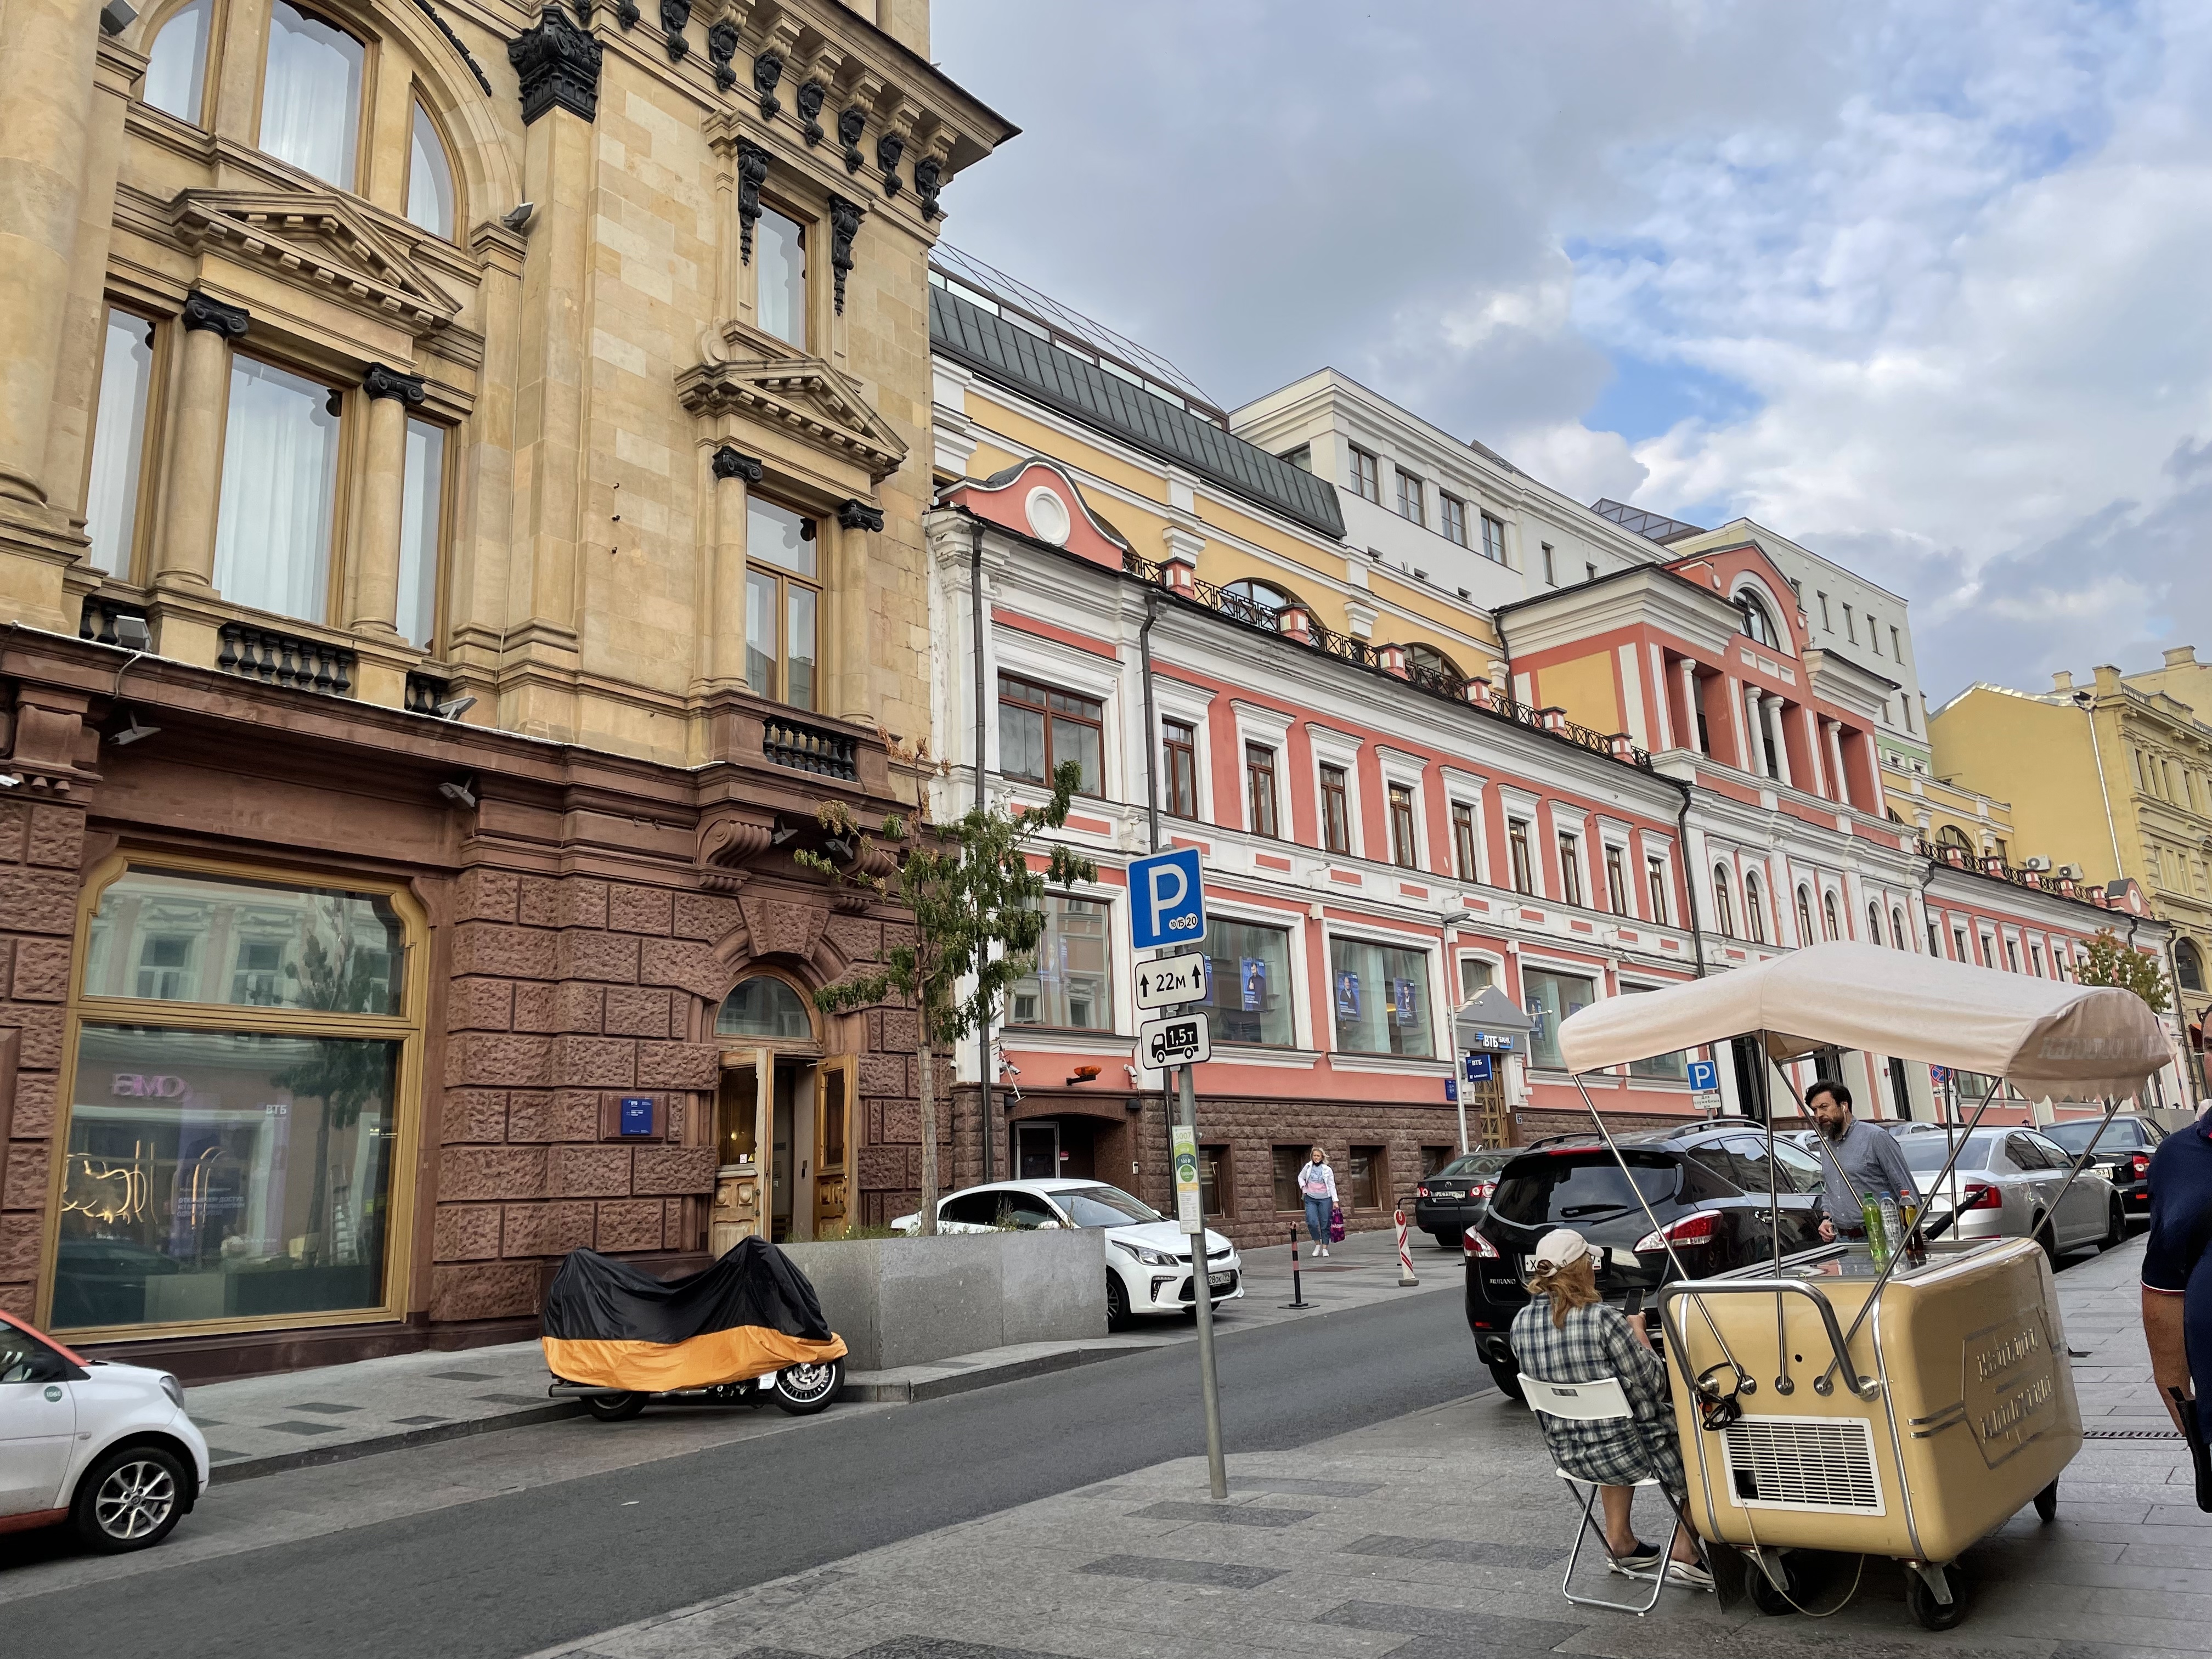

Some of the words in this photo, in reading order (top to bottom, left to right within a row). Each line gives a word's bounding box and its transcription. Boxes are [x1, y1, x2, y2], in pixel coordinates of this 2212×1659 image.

[1148, 863, 1188, 937] P
[1178, 919, 1184, 927] 15
[1186, 916, 1197, 926] 20
[1483, 1035, 1498, 1048] ВТБ
[1694, 1065, 1711, 1087] P
[266, 1104, 287, 1114] ВТБ
[1175, 1132, 1192, 1140] 5007
